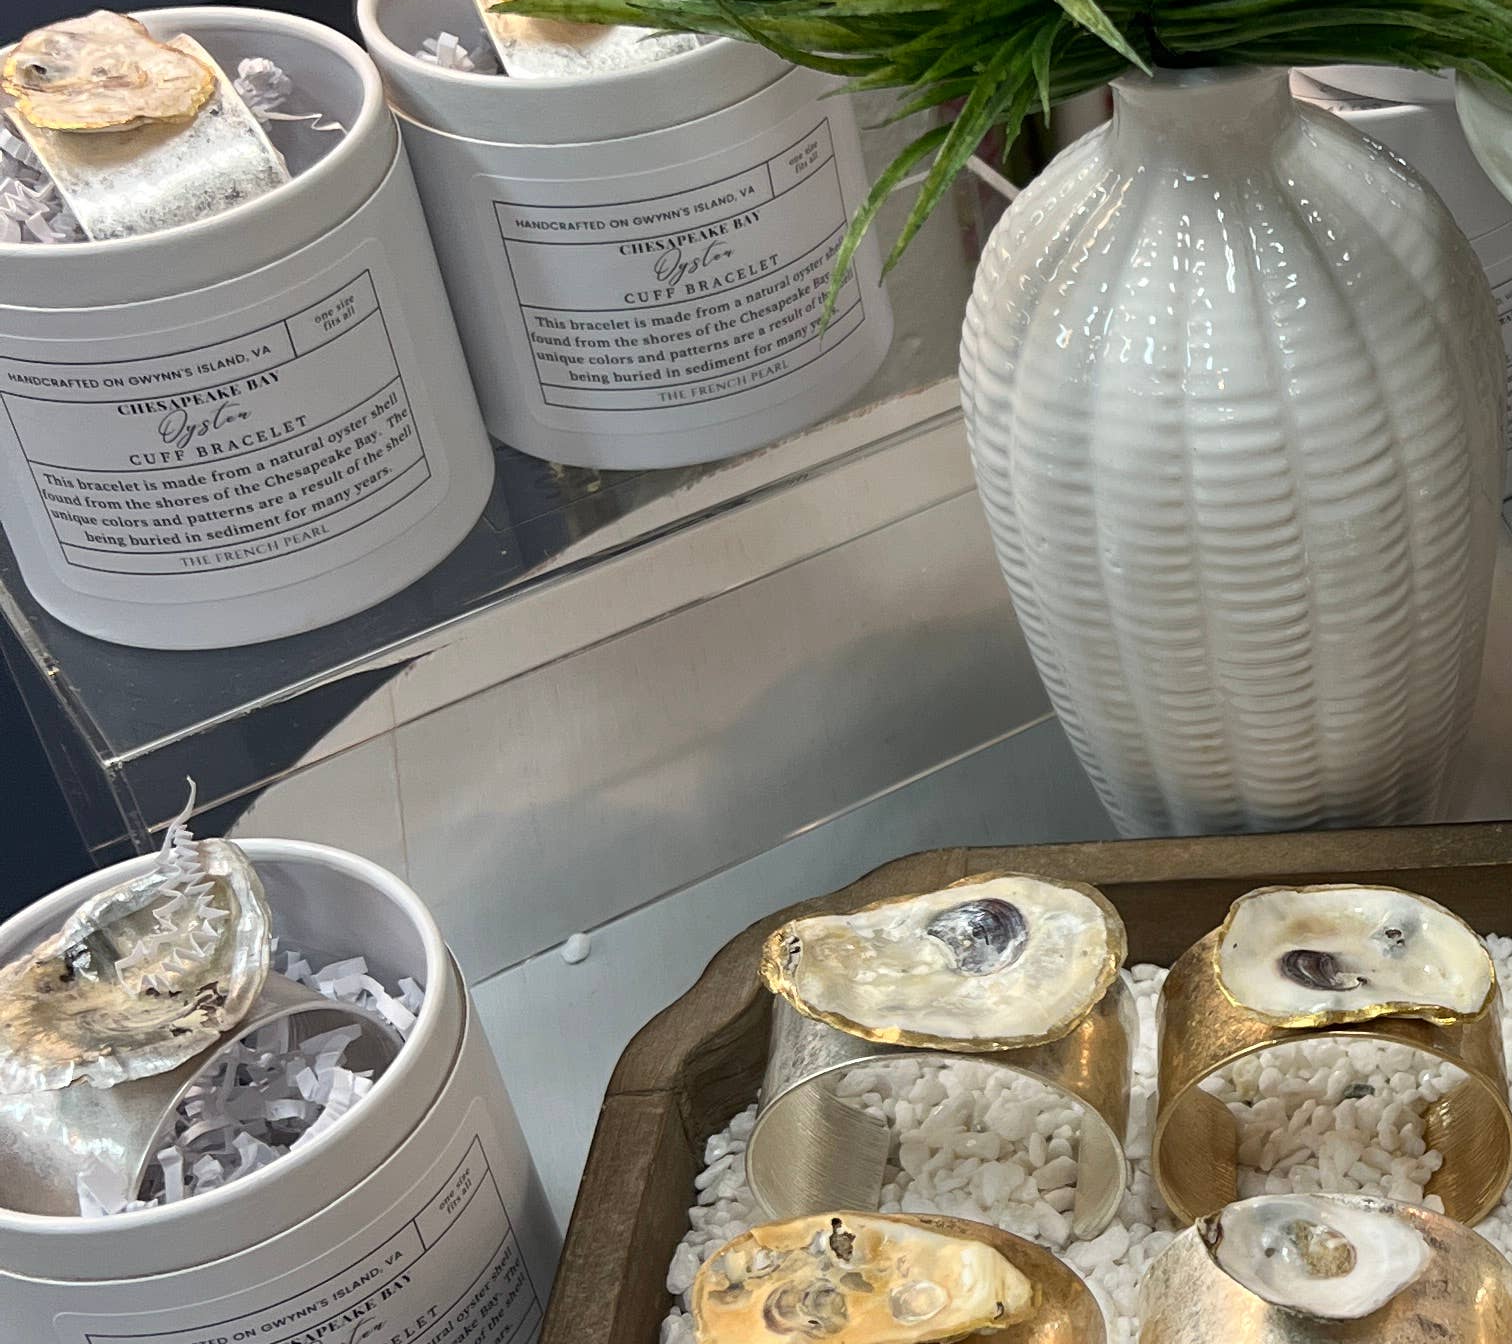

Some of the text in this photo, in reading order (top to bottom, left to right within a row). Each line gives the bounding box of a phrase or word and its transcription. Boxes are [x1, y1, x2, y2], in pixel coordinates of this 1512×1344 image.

[515, 185, 755, 231] HANDCRAFTED ON GWYNN'S ISLAND, VA
[619, 210, 761, 257] CHESAPEAKE BAY
[624, 253, 778, 304] CUFF BRACELET
[654, 240, 736, 286] Oyster
[314, 309, 334, 323] one
[323, 305, 356, 332] fits all
[7, 345, 271, 389] HANDCRAFTED ON GWYNN'S ISLAND, VA
[568, 326, 807, 385] being buried in sediment for many
[117, 370, 281, 416] CHESAPEAKE BAY
[43, 392, 398, 494] This bracelet is made from a natural oyster shell
[129, 415, 306, 466] CUFF BRACELET
[158, 402, 253, 448] Oyster
[179, 524, 330, 567] THE FRENCH PEARL
[232, 1328, 257, 1341] ON
[260, 1298, 329, 1332] GWYNN'S
[332, 1268, 383, 1301] ISLAND,
[384, 1251, 403, 1265] VA
[380, 1272, 412, 1301] BAY
